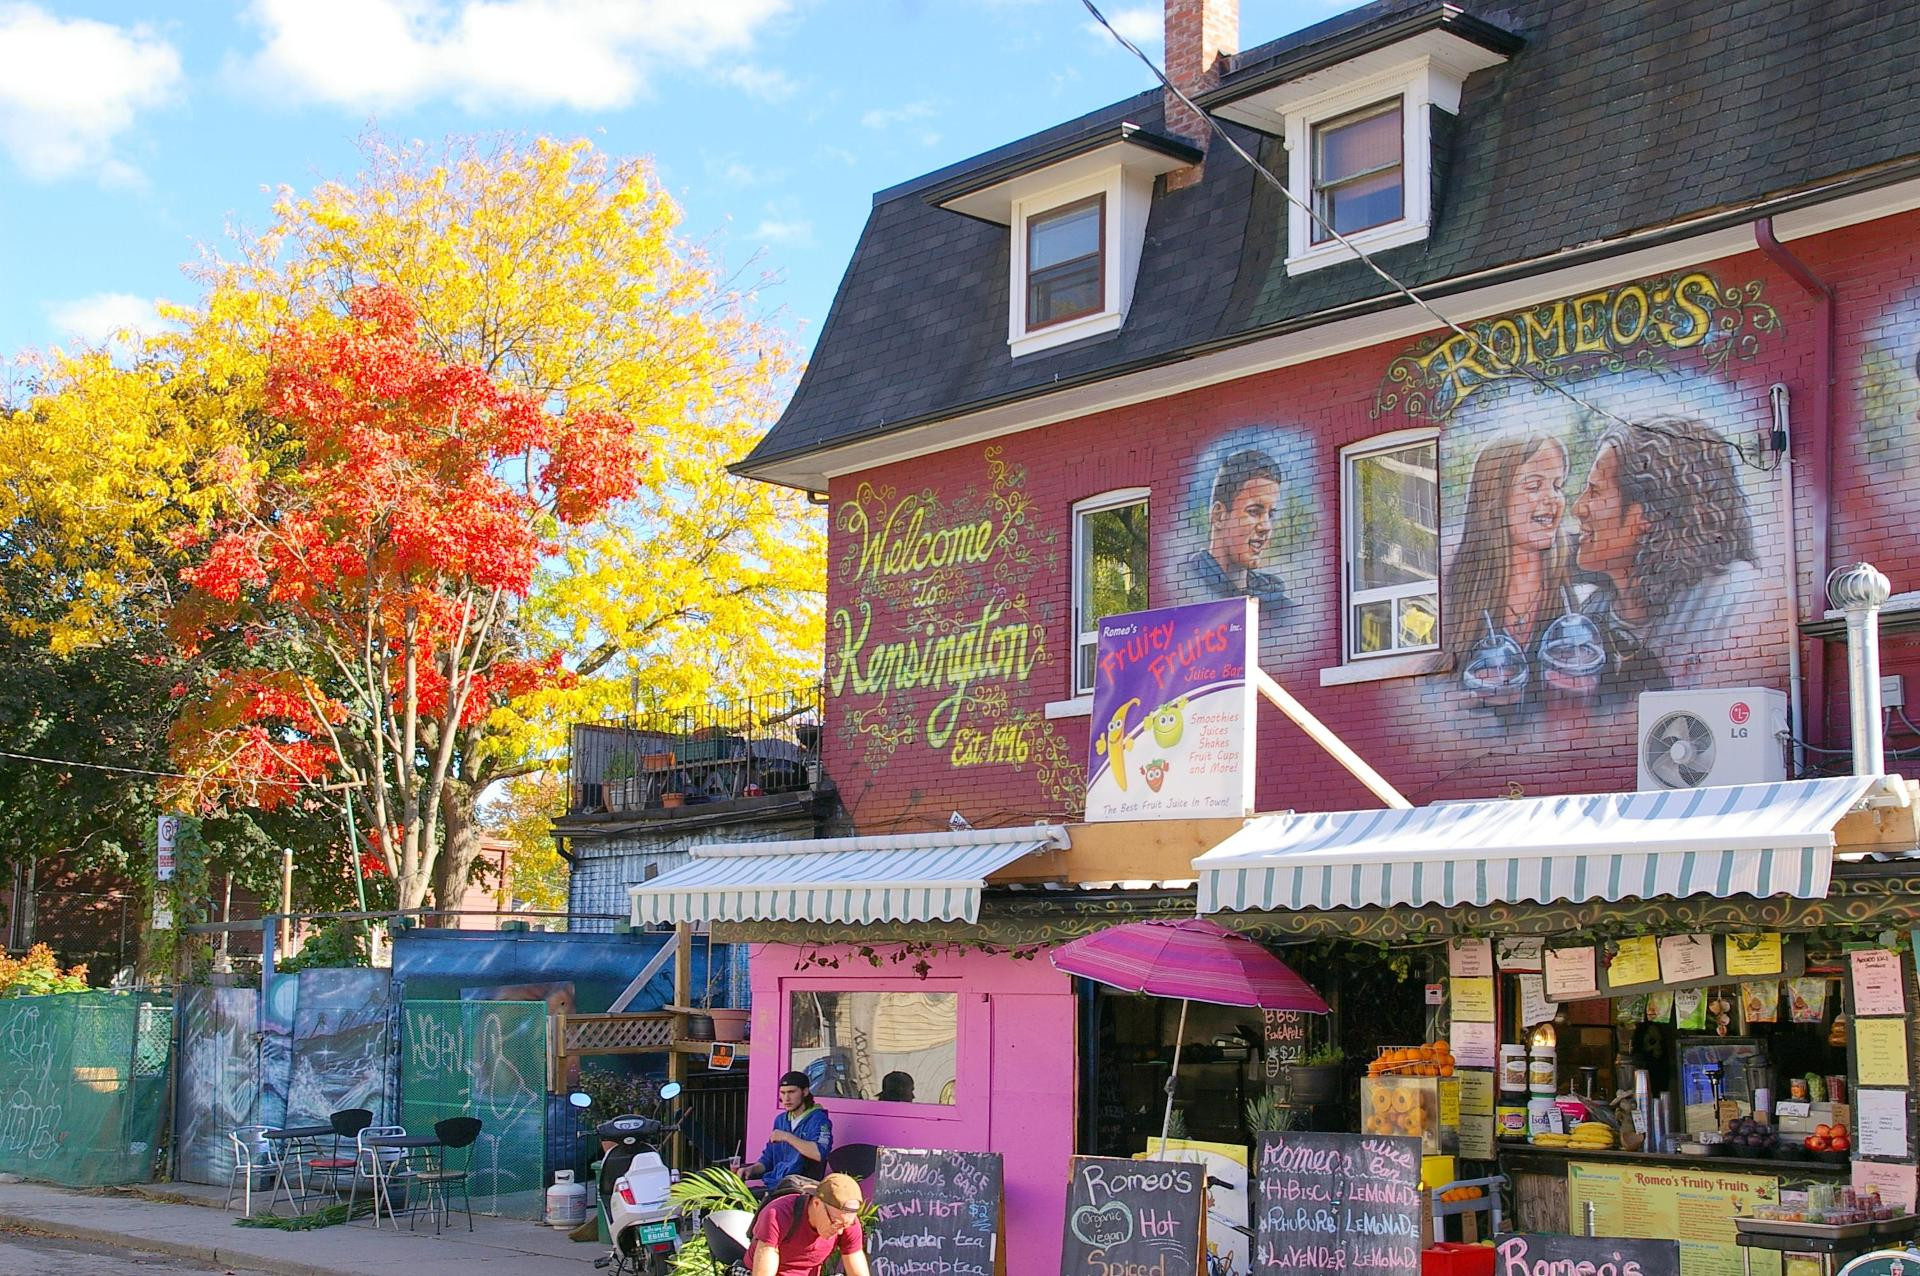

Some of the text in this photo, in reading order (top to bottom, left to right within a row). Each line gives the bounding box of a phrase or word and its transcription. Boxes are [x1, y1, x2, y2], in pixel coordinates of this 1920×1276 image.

[838, 490, 994, 582] Welcome
[1103, 623, 1138, 638] Romeo's
[1100, 620, 1176, 686] Fruity
[1148, 622, 1229, 689] Fruits
[829, 597, 1031, 749] Kensington
[1184, 664, 1244, 681] Juice Bar
[1191, 712, 1240, 724] Smoothies
[1200, 725, 1229, 737] Juices
[1731, 728, 1748, 739] LG
[1199, 737, 1230, 749] Shakes
[1189, 751, 1240, 763] Fruit Cups
[1190, 765, 1205, 774] and
[1104, 804, 1117, 815] The
[1121, 803, 1138, 813] Best
[1142, 800, 1162, 810] Fruit
[1166, 798, 1188, 809] Juice
[1264, 1010, 1300, 1023] BBQ
[880, 1152, 946, 1187] Romeo's
[1083, 1165, 1192, 1206] Romeo's
[1634, 1172, 1749, 1192] Romeo's Fruity Fruits
[1349, 1182, 1421, 1206] LEMONADE
[878, 1199, 924, 1222] NEW!
[929, 1200, 964, 1218] HOT
[1081, 1208, 1180, 1238] Organic Hot
[1345, 1208, 1420, 1238] LEMONADE
[953, 1229, 985, 1248] tea
[1268, 1241, 1346, 1271] LAVENDER
